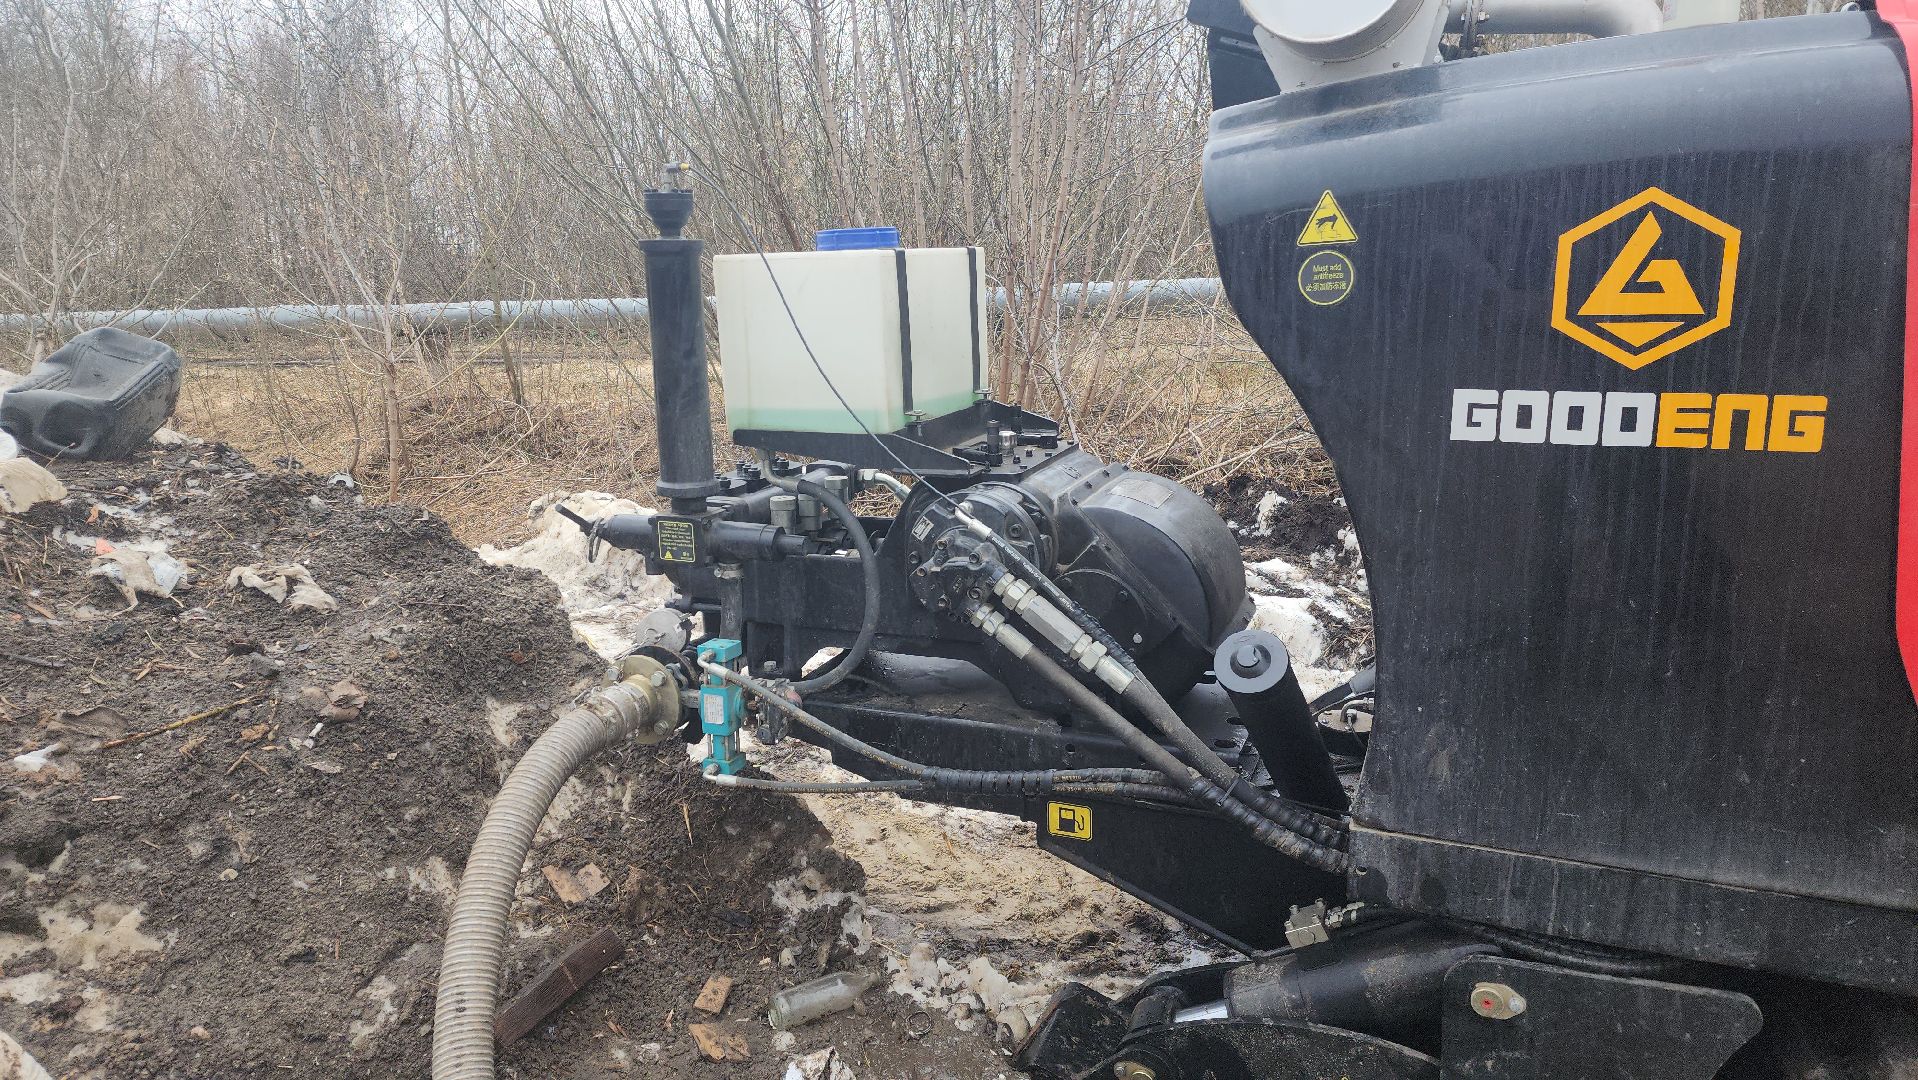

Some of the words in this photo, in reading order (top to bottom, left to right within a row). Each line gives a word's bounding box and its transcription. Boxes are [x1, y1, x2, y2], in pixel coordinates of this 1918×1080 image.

[1312, 264, 1328, 272] Must
[1330, 263, 1342, 271] add
[1313, 272, 1344, 280] antifreeze
[1450, 388, 1828, 453] GOODENG
